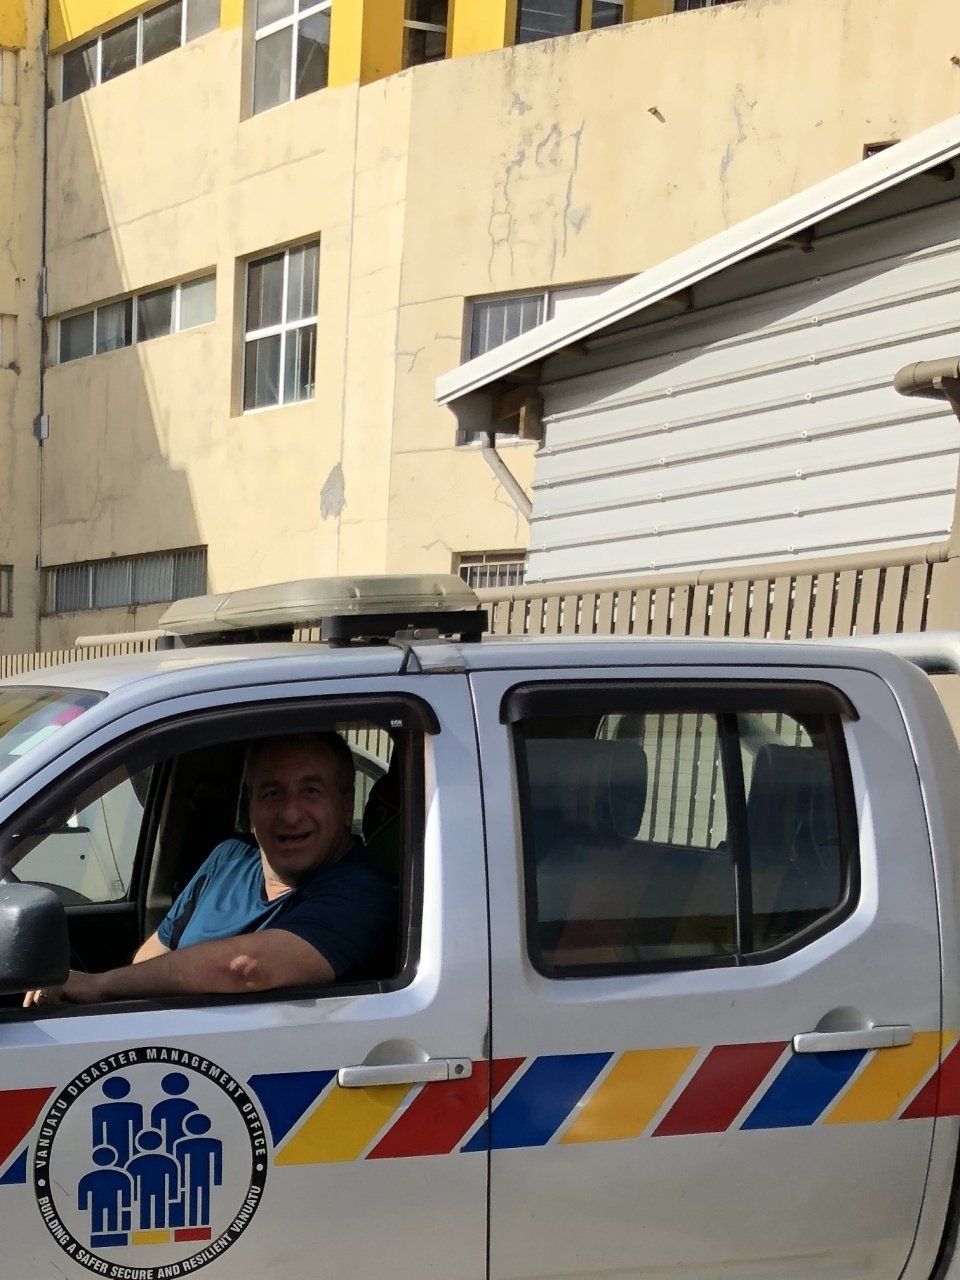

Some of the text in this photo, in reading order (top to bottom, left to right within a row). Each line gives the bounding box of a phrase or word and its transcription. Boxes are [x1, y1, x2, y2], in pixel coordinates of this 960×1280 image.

[36, 1049, 265, 1168] VANUATU DISASTER MANAGEMENT OFFICE
[38, 1184, 262, 1279] BUILDING A SAFER SECURE AND RESILIENT VANUATU
